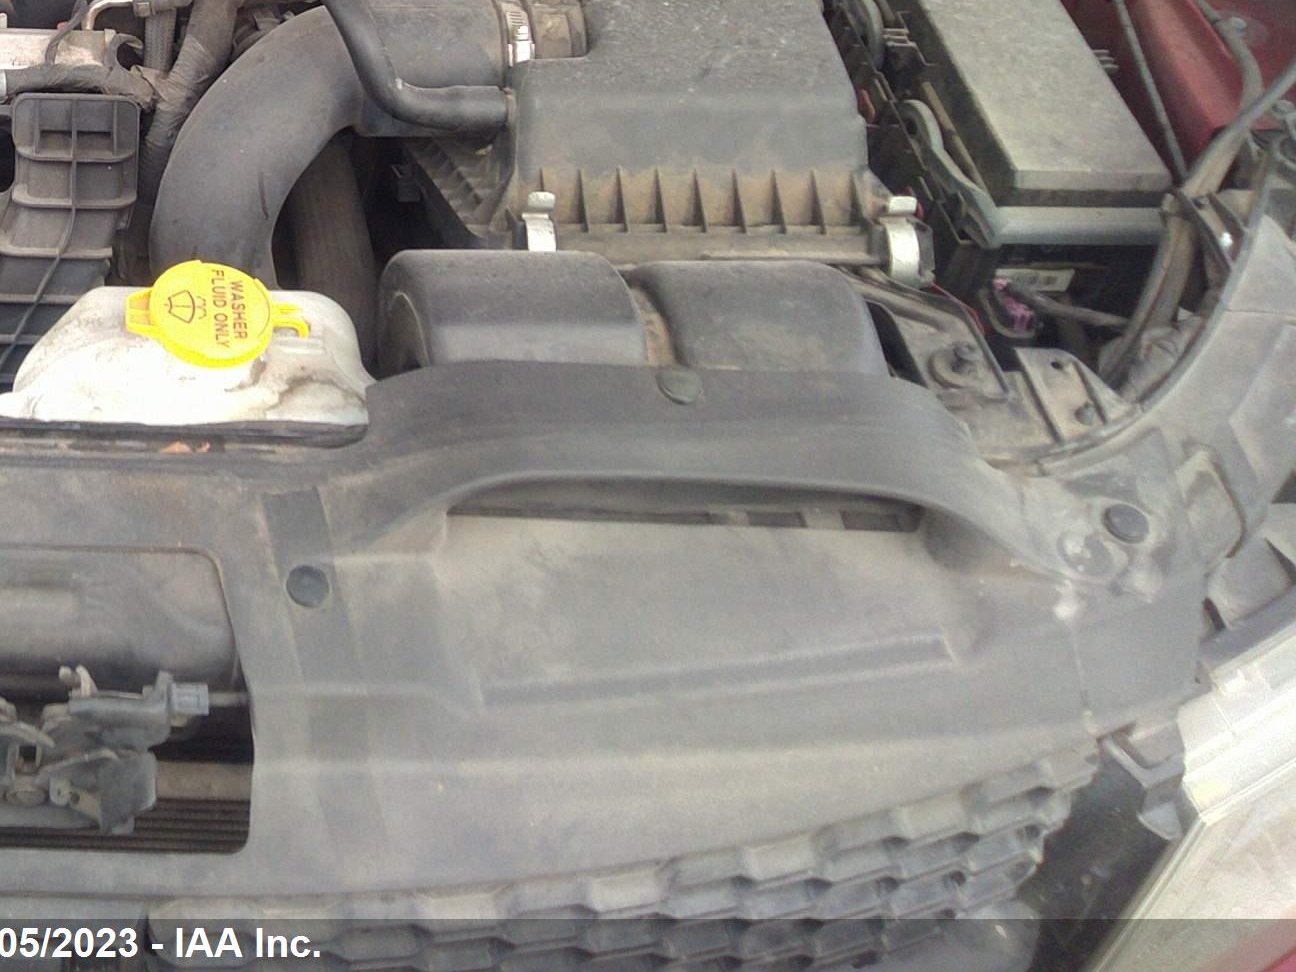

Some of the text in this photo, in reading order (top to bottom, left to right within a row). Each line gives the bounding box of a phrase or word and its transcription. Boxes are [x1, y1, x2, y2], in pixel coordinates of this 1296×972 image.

[211, 270, 230, 348] FLUID ONLY
[230, 280, 248, 339] WASHER
